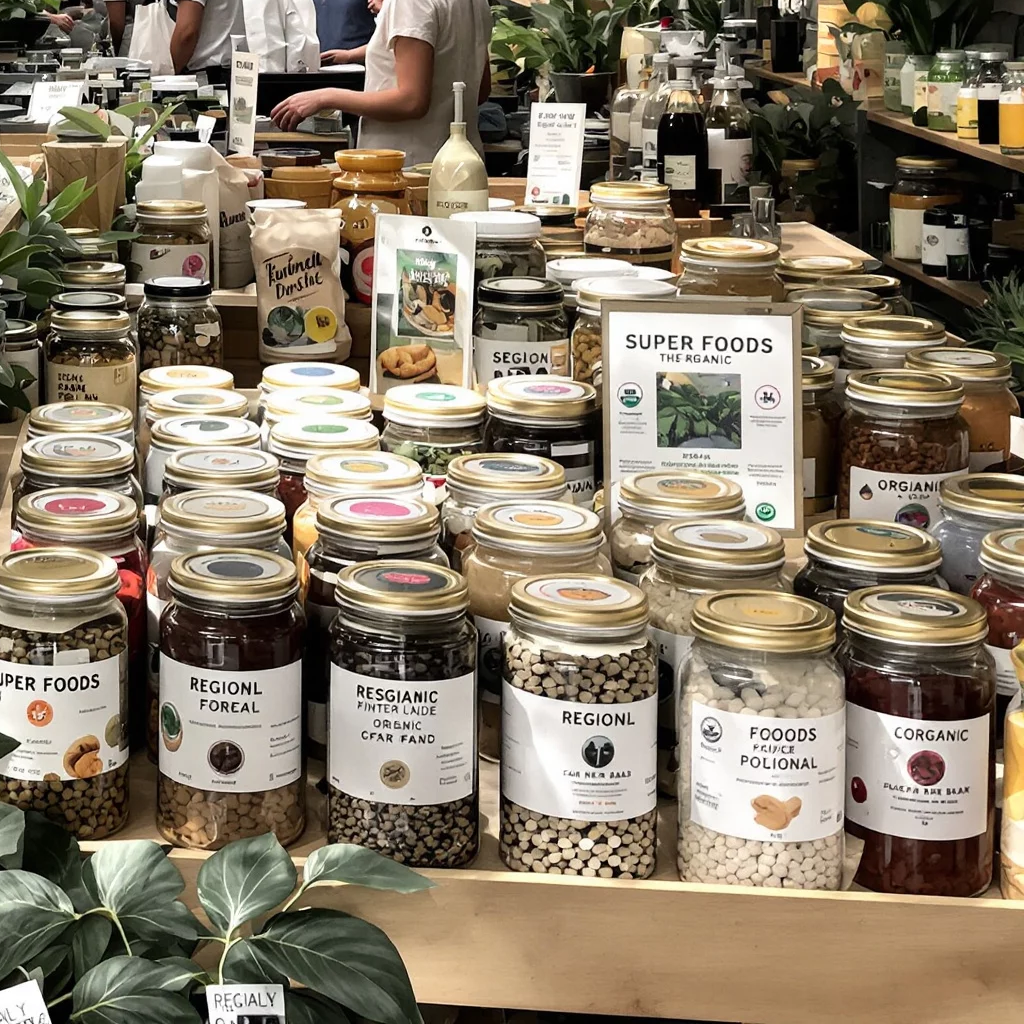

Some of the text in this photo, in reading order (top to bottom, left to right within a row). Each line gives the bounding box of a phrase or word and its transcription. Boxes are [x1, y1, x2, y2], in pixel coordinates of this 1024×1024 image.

[626, 334, 773, 354] SUPER FOODS
[877, 479, 943, 492] ORGIANI
[43, 673, 100, 693] FOODS
[190, 676, 263, 696] REGIONL
[356, 684, 439, 704] RESGIANIC
[199, 698, 260, 714] FOREAL
[562, 710, 636, 727] REGIONL
[749, 726, 817, 742] FOOODS
[894, 726, 969, 742] CORGANIC
[740, 754, 818, 770] POLIONAL
